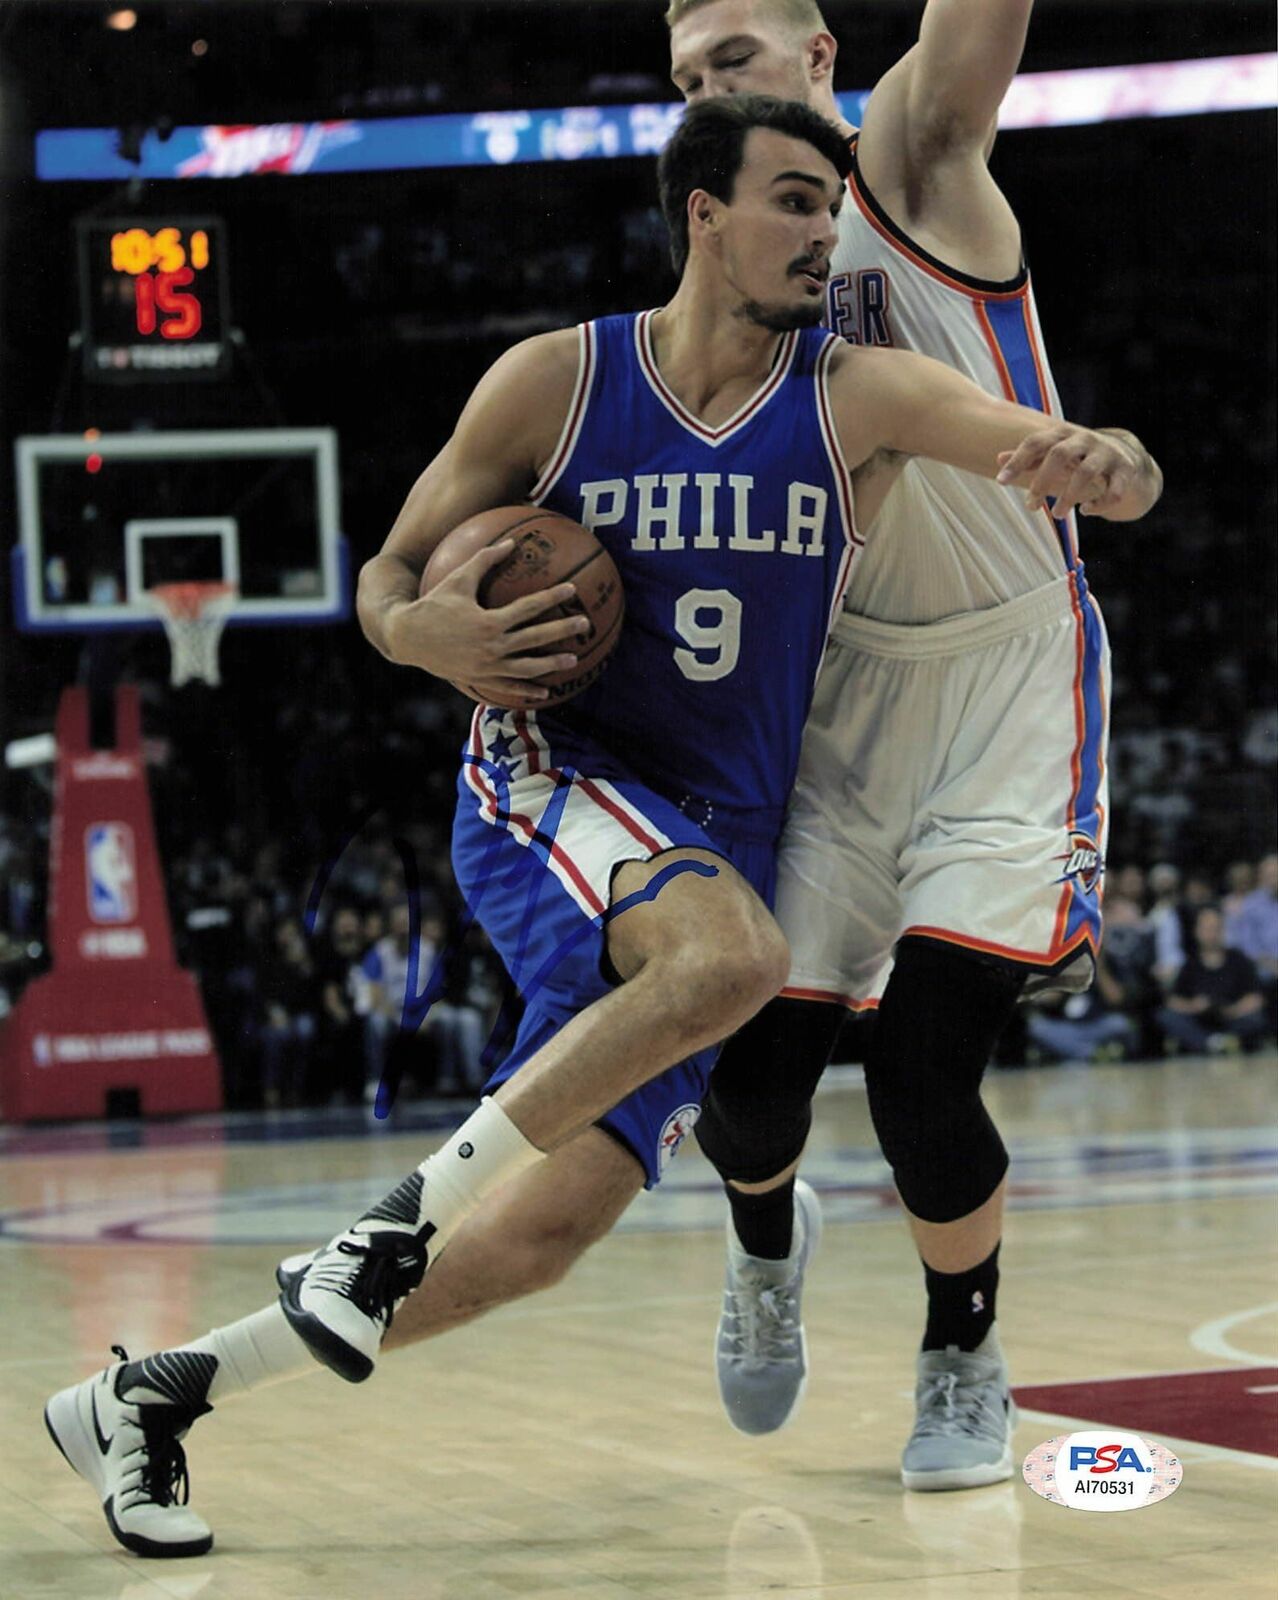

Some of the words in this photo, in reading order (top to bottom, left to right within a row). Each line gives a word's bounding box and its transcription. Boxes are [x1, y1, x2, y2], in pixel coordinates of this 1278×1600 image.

[135, 268, 202, 339] 15
[579, 473, 828, 557] PHILA
[672, 587, 743, 682] 9
